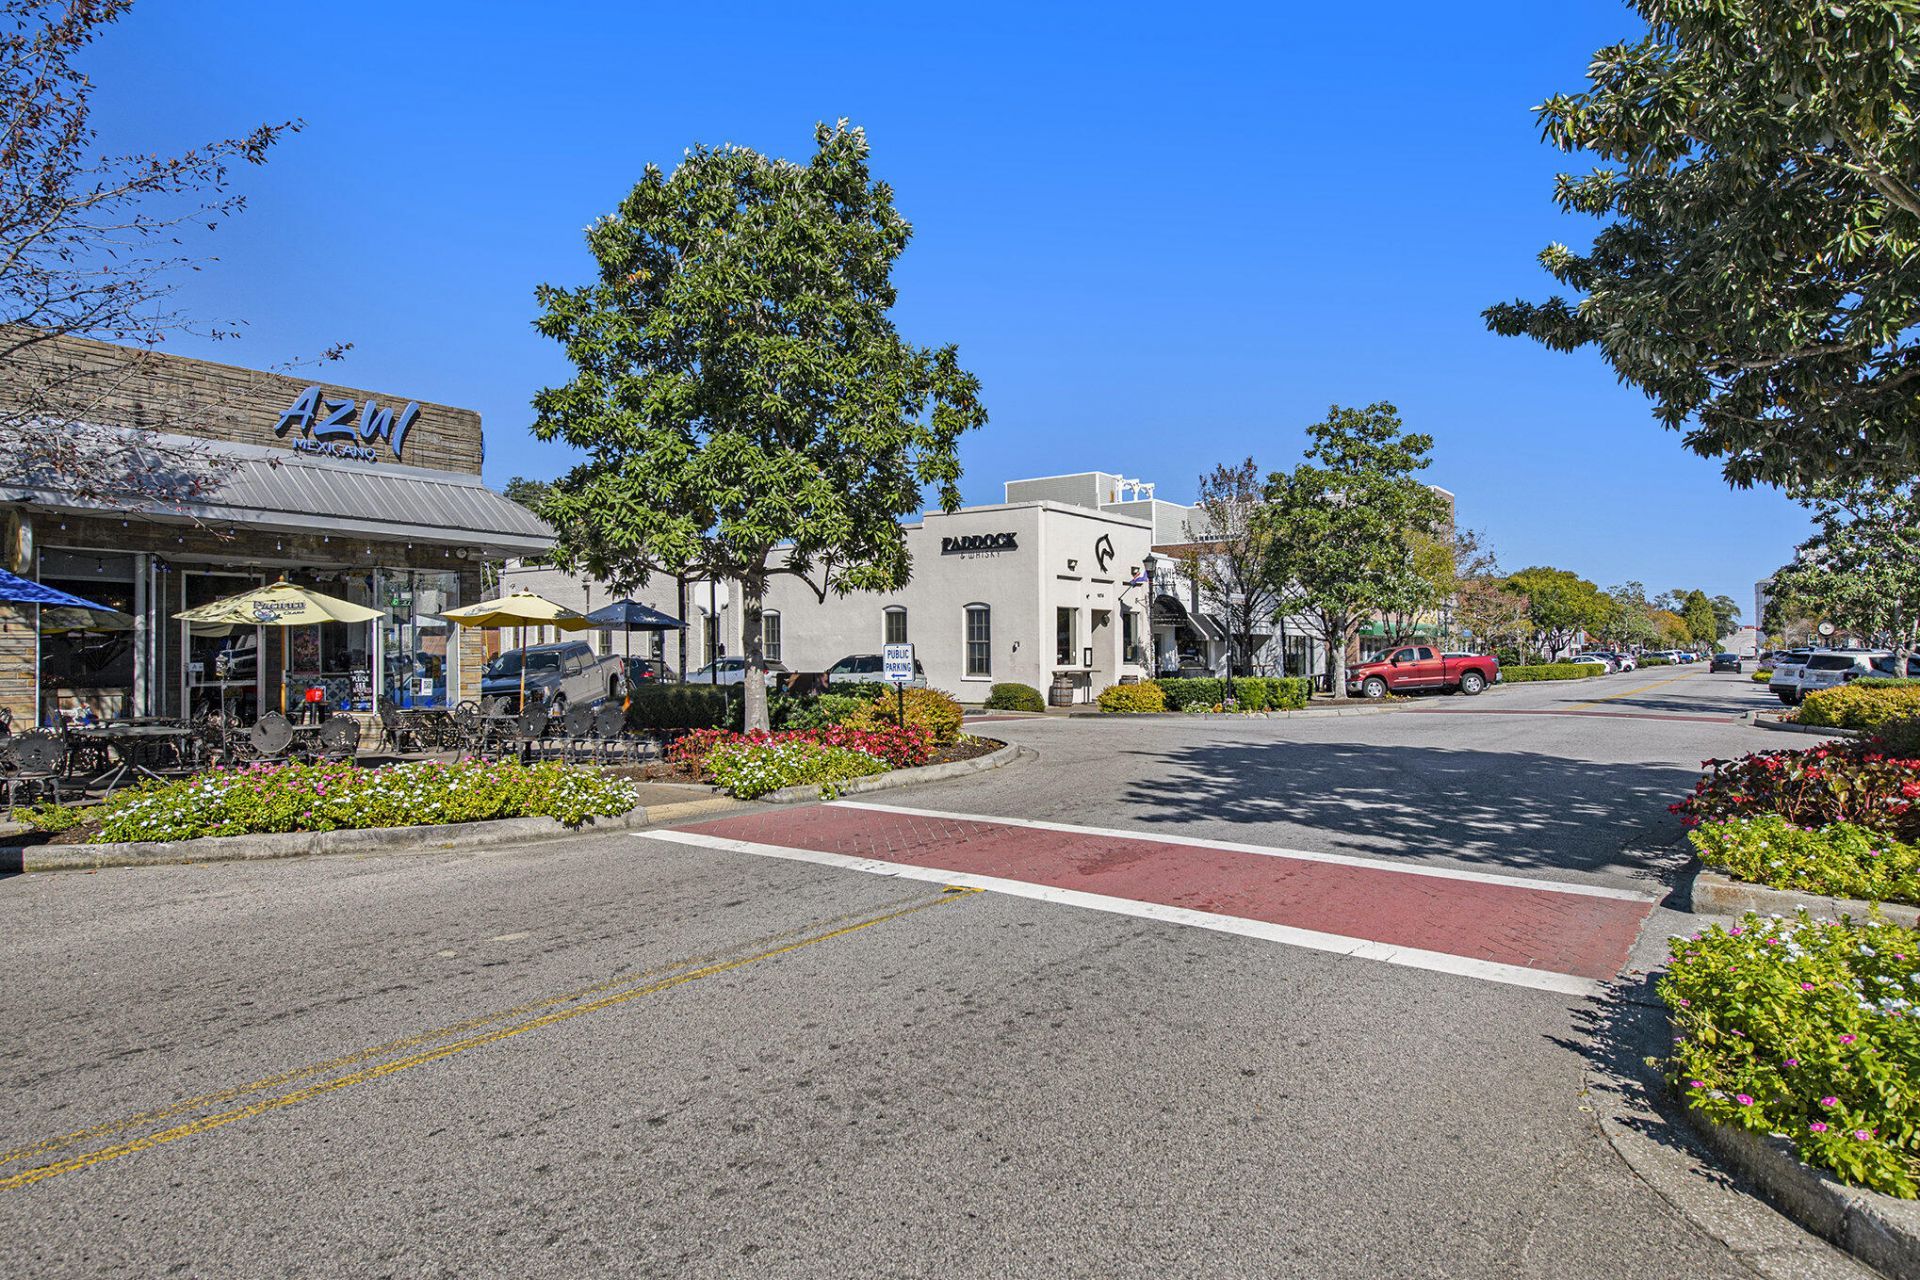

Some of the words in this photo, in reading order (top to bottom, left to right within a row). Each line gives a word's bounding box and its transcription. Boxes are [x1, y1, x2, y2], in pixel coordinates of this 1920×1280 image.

[293, 437, 376, 460] MEXICANO
[941, 532, 1018, 553] PADDOCK
[887, 649, 910, 659] PUBLIC
[885, 662, 912, 672] PARKING
